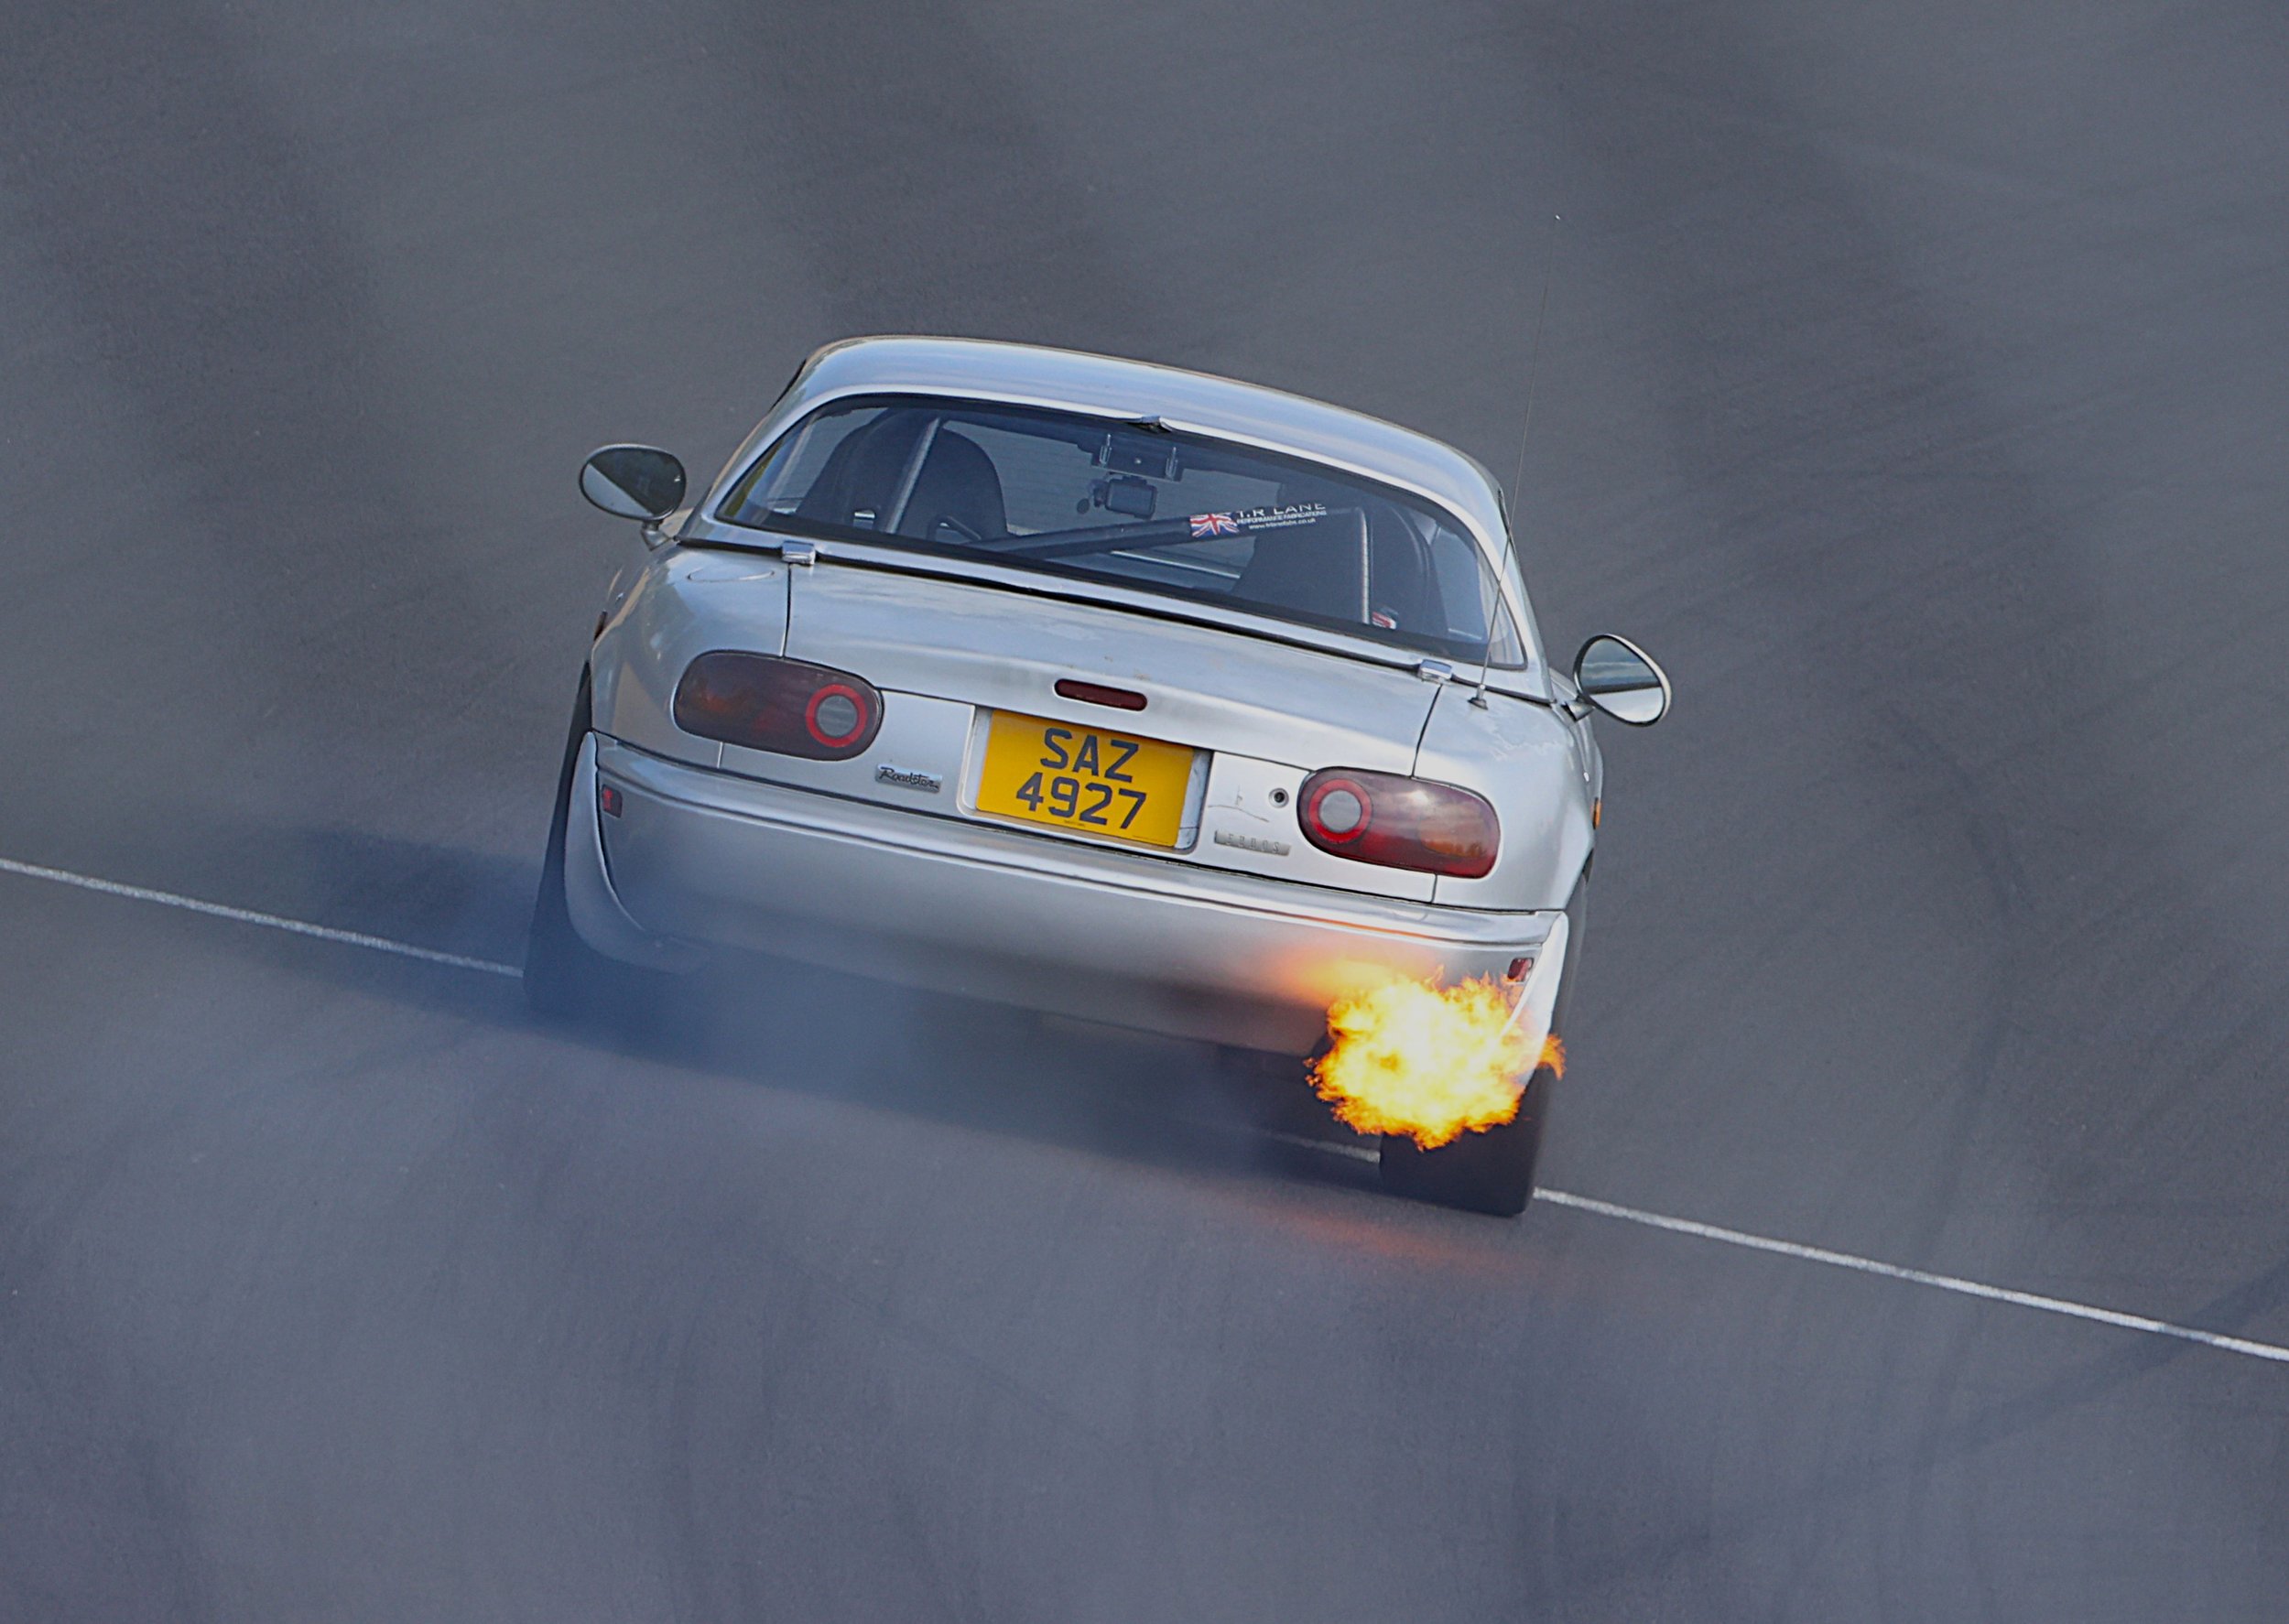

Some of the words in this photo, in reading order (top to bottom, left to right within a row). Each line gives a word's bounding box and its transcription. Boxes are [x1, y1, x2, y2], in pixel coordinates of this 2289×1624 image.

[1236, 514, 1283, 525] PERFORMANCE
[1283, 510, 1327, 520] FABRICATIONS
[1274, 503, 1326, 514] LANE
[1040, 728, 1139, 783] SAZ
[1016, 772, 1147, 829] 4927
